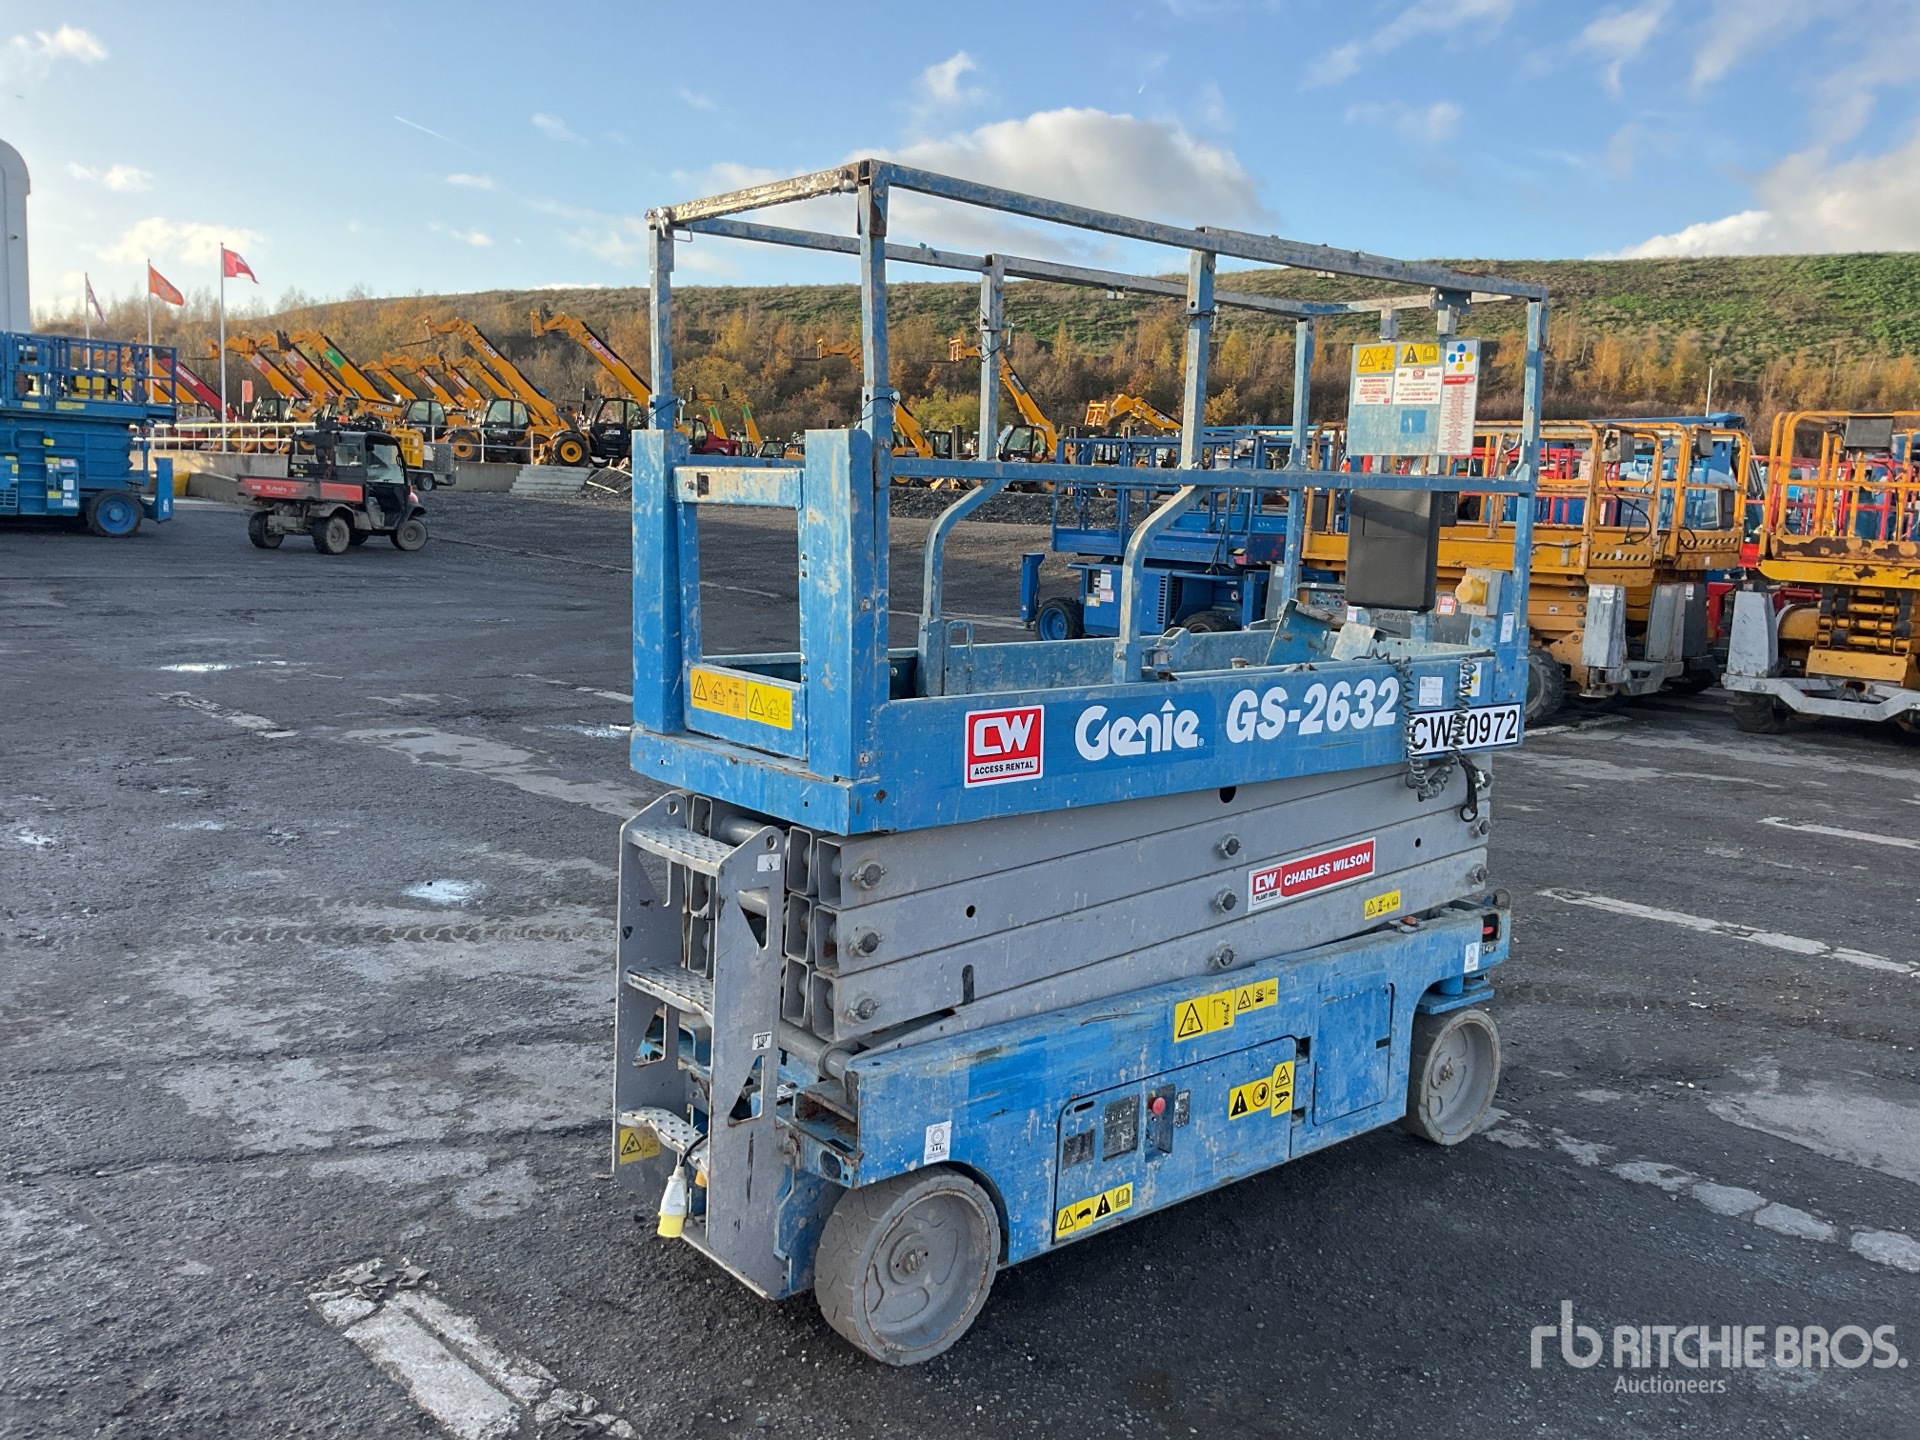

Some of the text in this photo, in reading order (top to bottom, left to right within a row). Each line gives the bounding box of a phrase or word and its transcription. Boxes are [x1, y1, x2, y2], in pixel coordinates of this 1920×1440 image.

[375, 404, 393, 413] JCB
[1226, 677, 1400, 744] GS-2632
[1466, 709, 1517, 746] 0972
[973, 713, 1035, 757] CW
[1075, 699, 1200, 762] Genie
[974, 760, 1034, 776] ACCESS RENTAL
[1255, 871, 1278, 892] CW
[1284, 852, 1371, 887] CHARLES WILSON
[1255, 889, 1278, 902] PLANT HIRE
